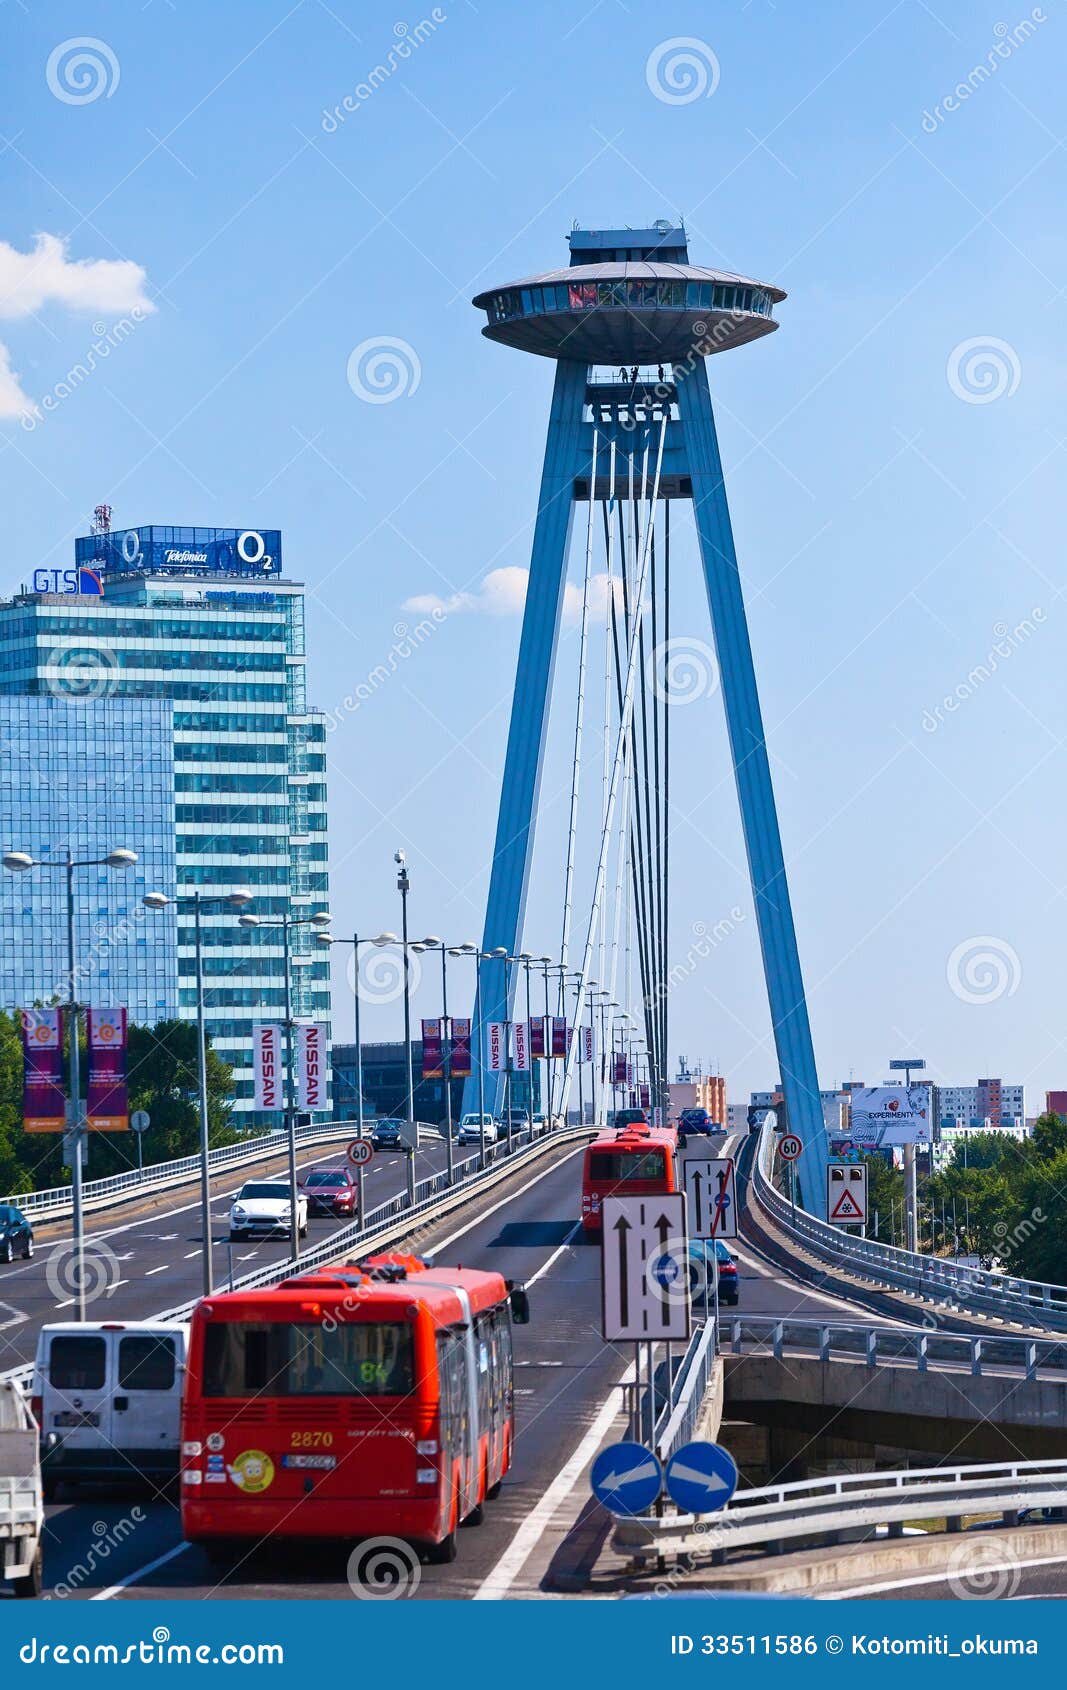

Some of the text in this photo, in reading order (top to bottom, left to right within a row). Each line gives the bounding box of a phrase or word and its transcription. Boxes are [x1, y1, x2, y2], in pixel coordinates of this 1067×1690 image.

[237, 531, 273, 570] O2
[33, 568, 77, 594] GTS
[491, 1025, 499, 1069] NISSAN
[516, 1024, 525, 1069] NISSAN
[261, 1029, 274, 1106] NISSAN
[306, 1028, 319, 1105] NISSAN
[353, 1146, 367, 1158] 60
[783, 1141, 797, 1153] 60
[291, 1432, 333, 1447] 2870
